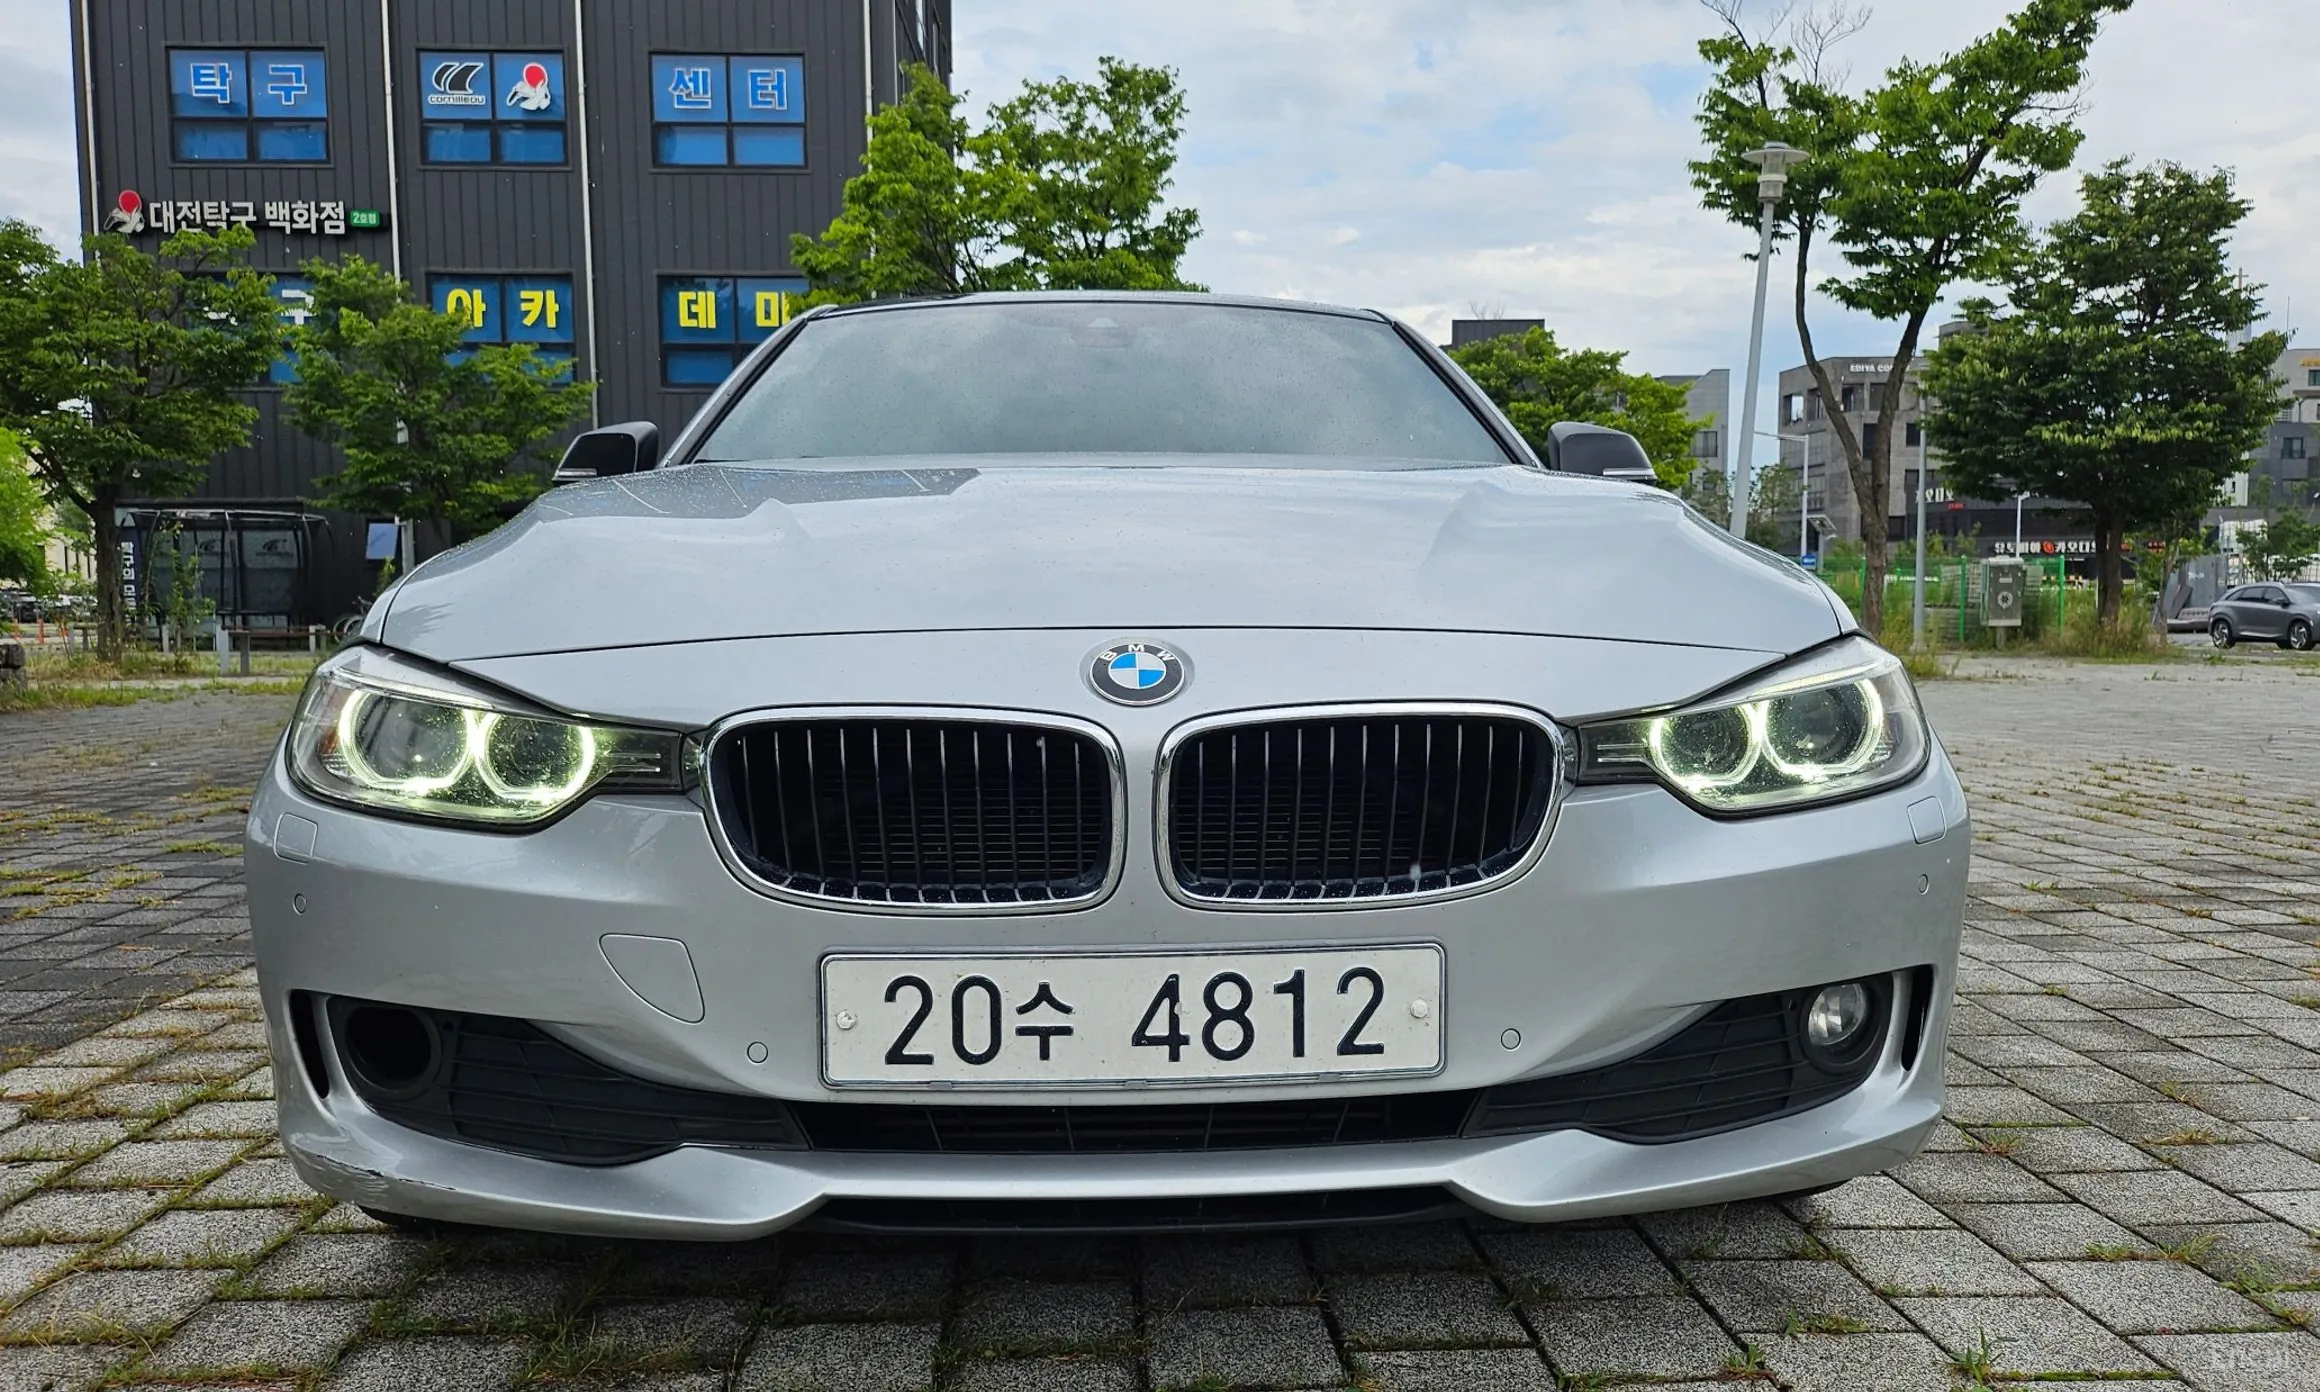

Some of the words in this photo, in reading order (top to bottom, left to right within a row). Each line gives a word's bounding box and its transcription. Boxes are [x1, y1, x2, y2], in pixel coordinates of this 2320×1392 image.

[190, 62, 308, 104] 탁구
[668, 67, 788, 110] 센터
[149, 200, 257, 234] 대전탁구
[264, 200, 346, 235] 백화점
[1100, 644, 1175, 662] BMW
[883, 974, 1074, 1066] 20수
[1130, 965, 1386, 1064] 4812
